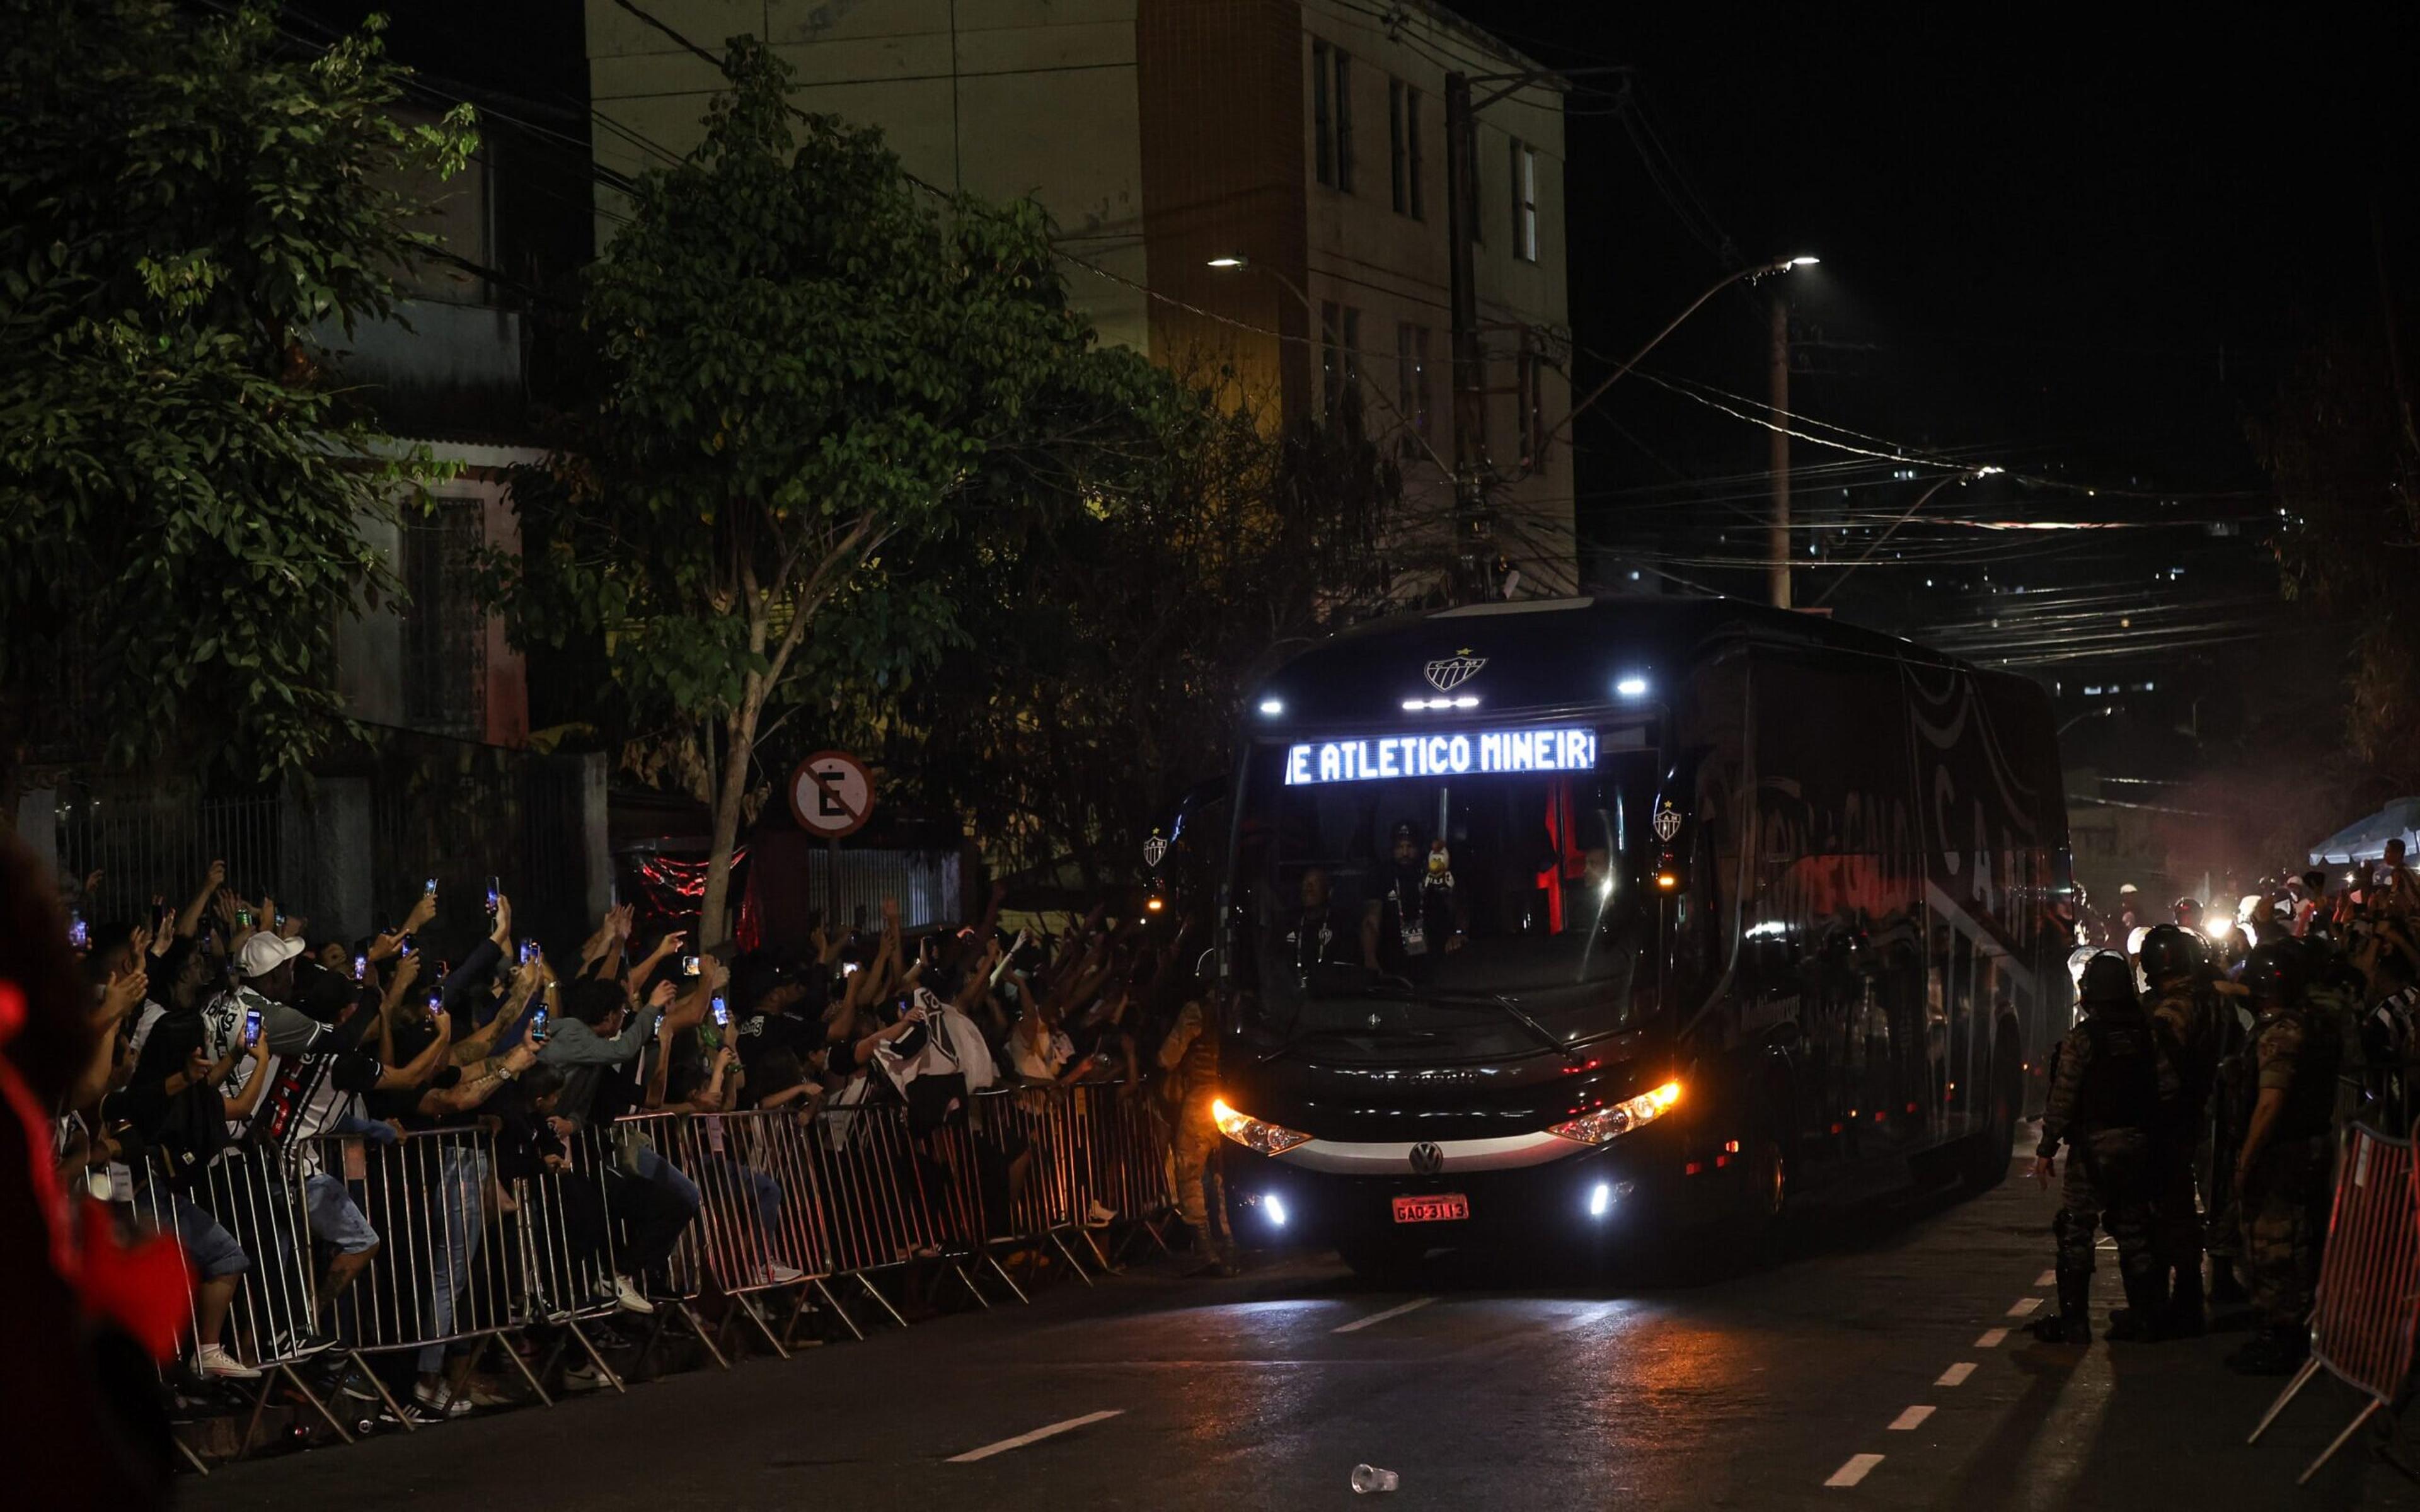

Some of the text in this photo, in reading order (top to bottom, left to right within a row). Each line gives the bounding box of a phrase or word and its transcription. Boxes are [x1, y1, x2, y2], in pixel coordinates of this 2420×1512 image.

[1284, 730, 1596, 785] E ATLETICO MINEIR
[819, 772, 846, 816] E
